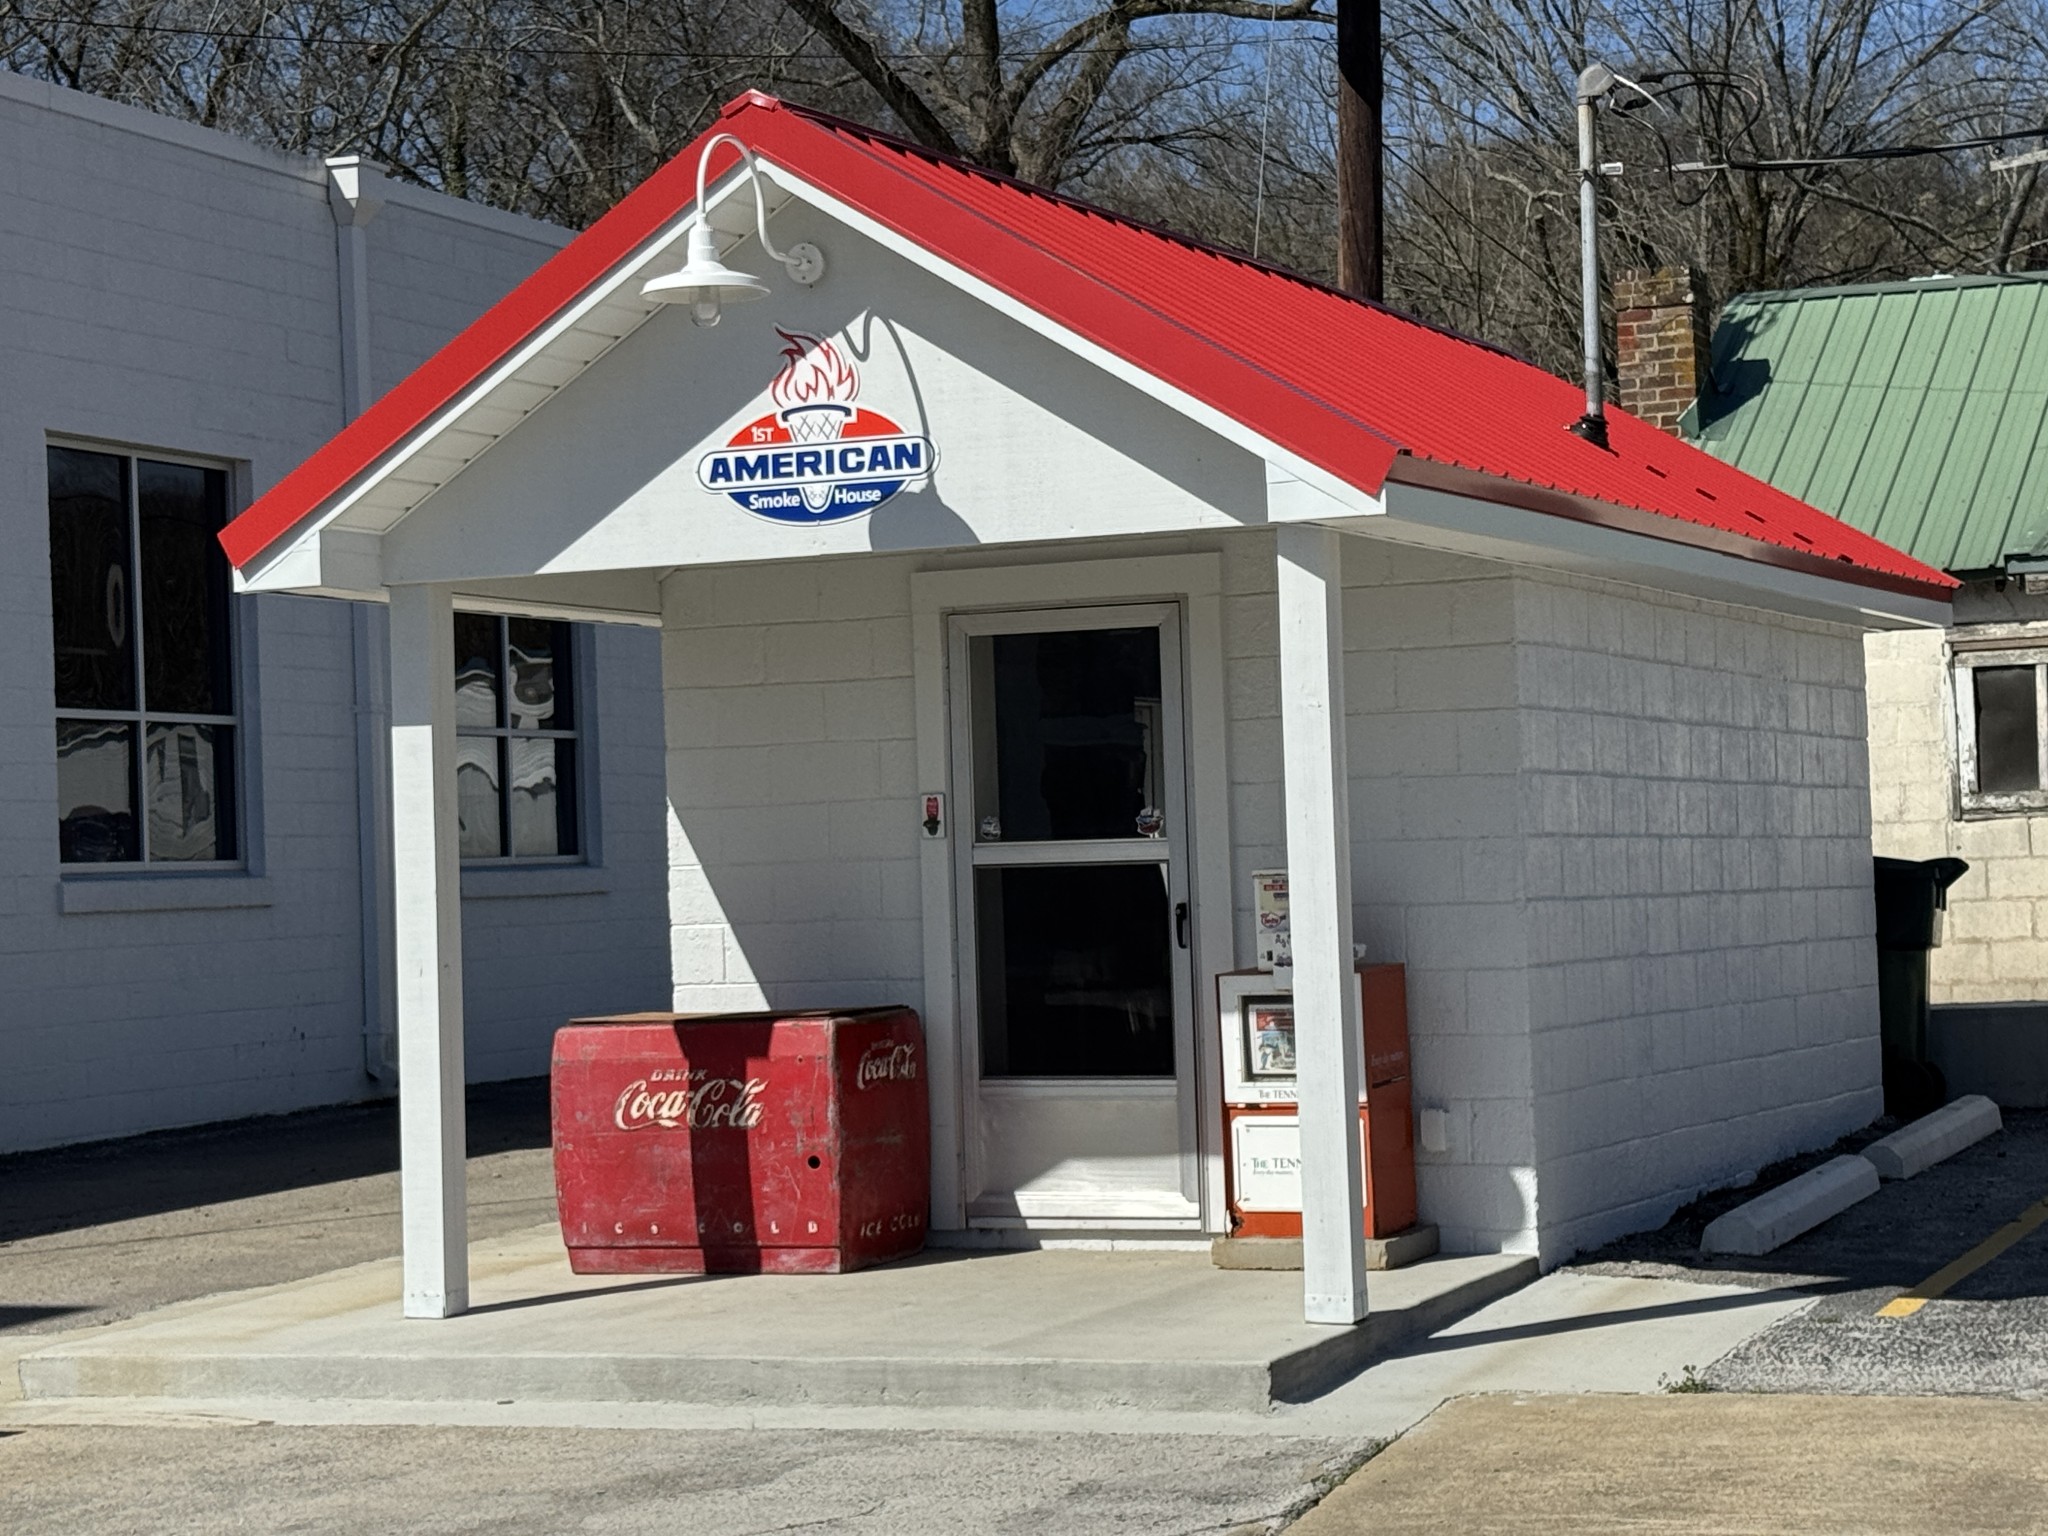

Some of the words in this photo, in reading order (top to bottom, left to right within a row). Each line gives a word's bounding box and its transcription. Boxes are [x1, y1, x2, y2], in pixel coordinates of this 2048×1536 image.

[751, 426, 775, 442] 1ST
[708, 443, 922, 484] AMERICAN
[748, 493, 801, 510] Smoke
[834, 489, 882, 504] House
[650, 1069, 708, 1082] DRINK
